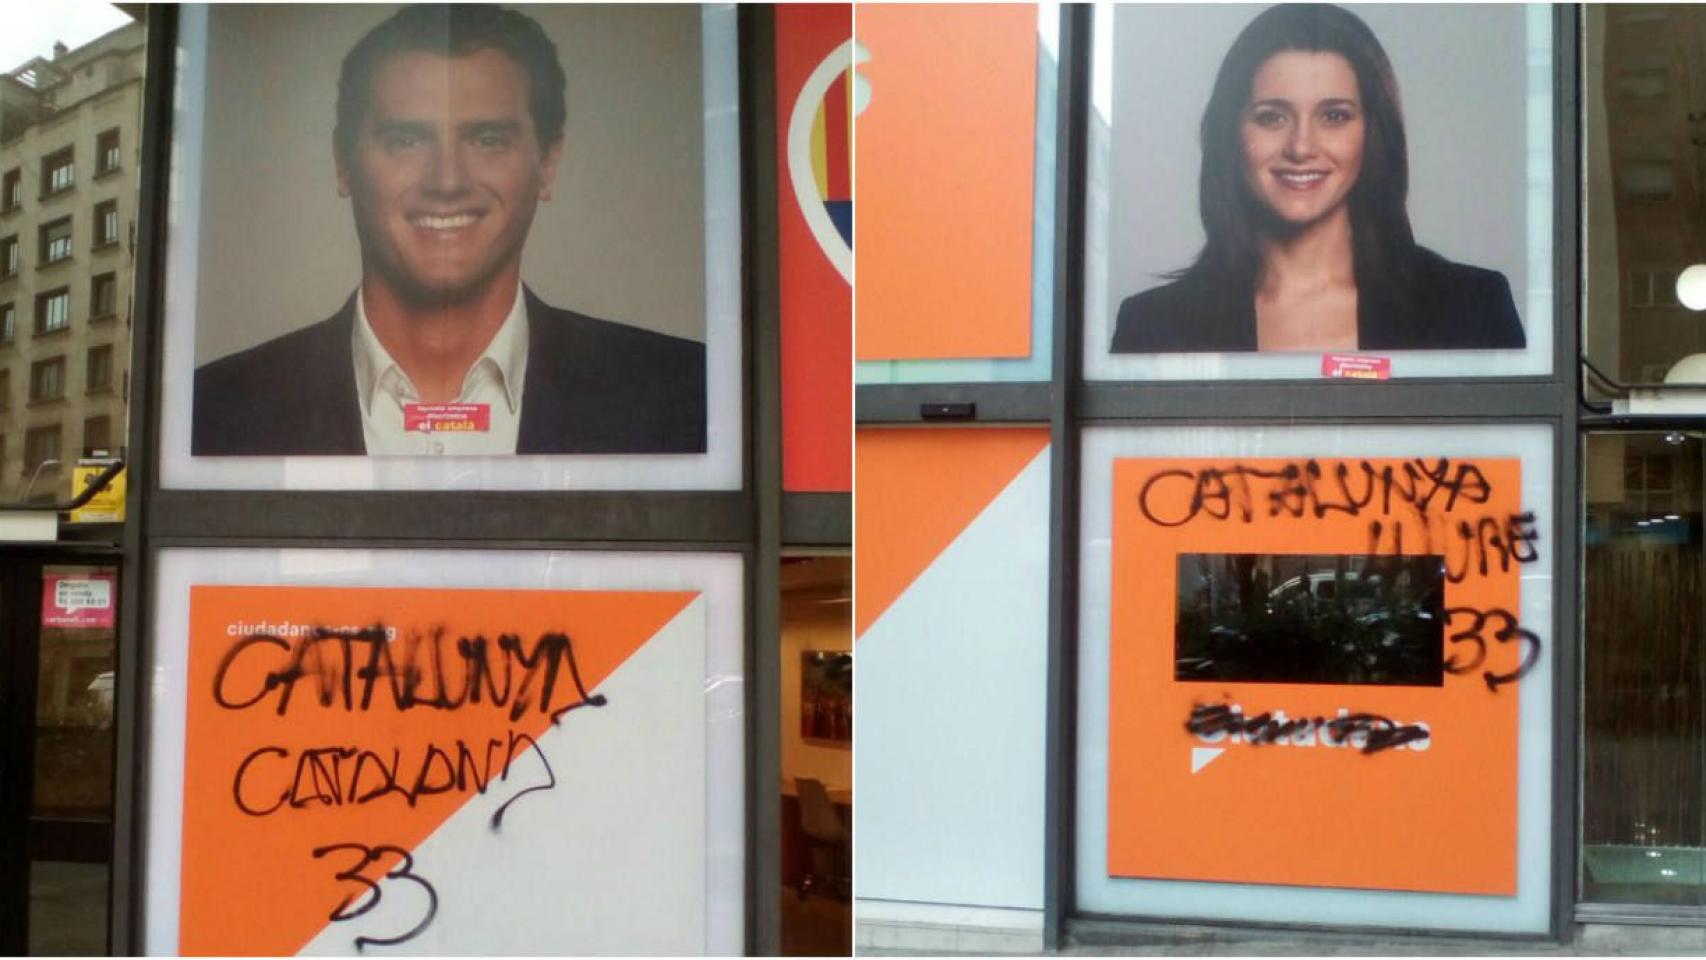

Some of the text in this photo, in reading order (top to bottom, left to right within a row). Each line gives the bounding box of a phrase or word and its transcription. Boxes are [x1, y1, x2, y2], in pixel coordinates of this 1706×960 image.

[1139, 458, 1491, 527] CATALUNYA
[213, 622, 608, 727] CATALUNYA
[1443, 607, 1541, 692] 33
[312, 842, 438, 954] 33
